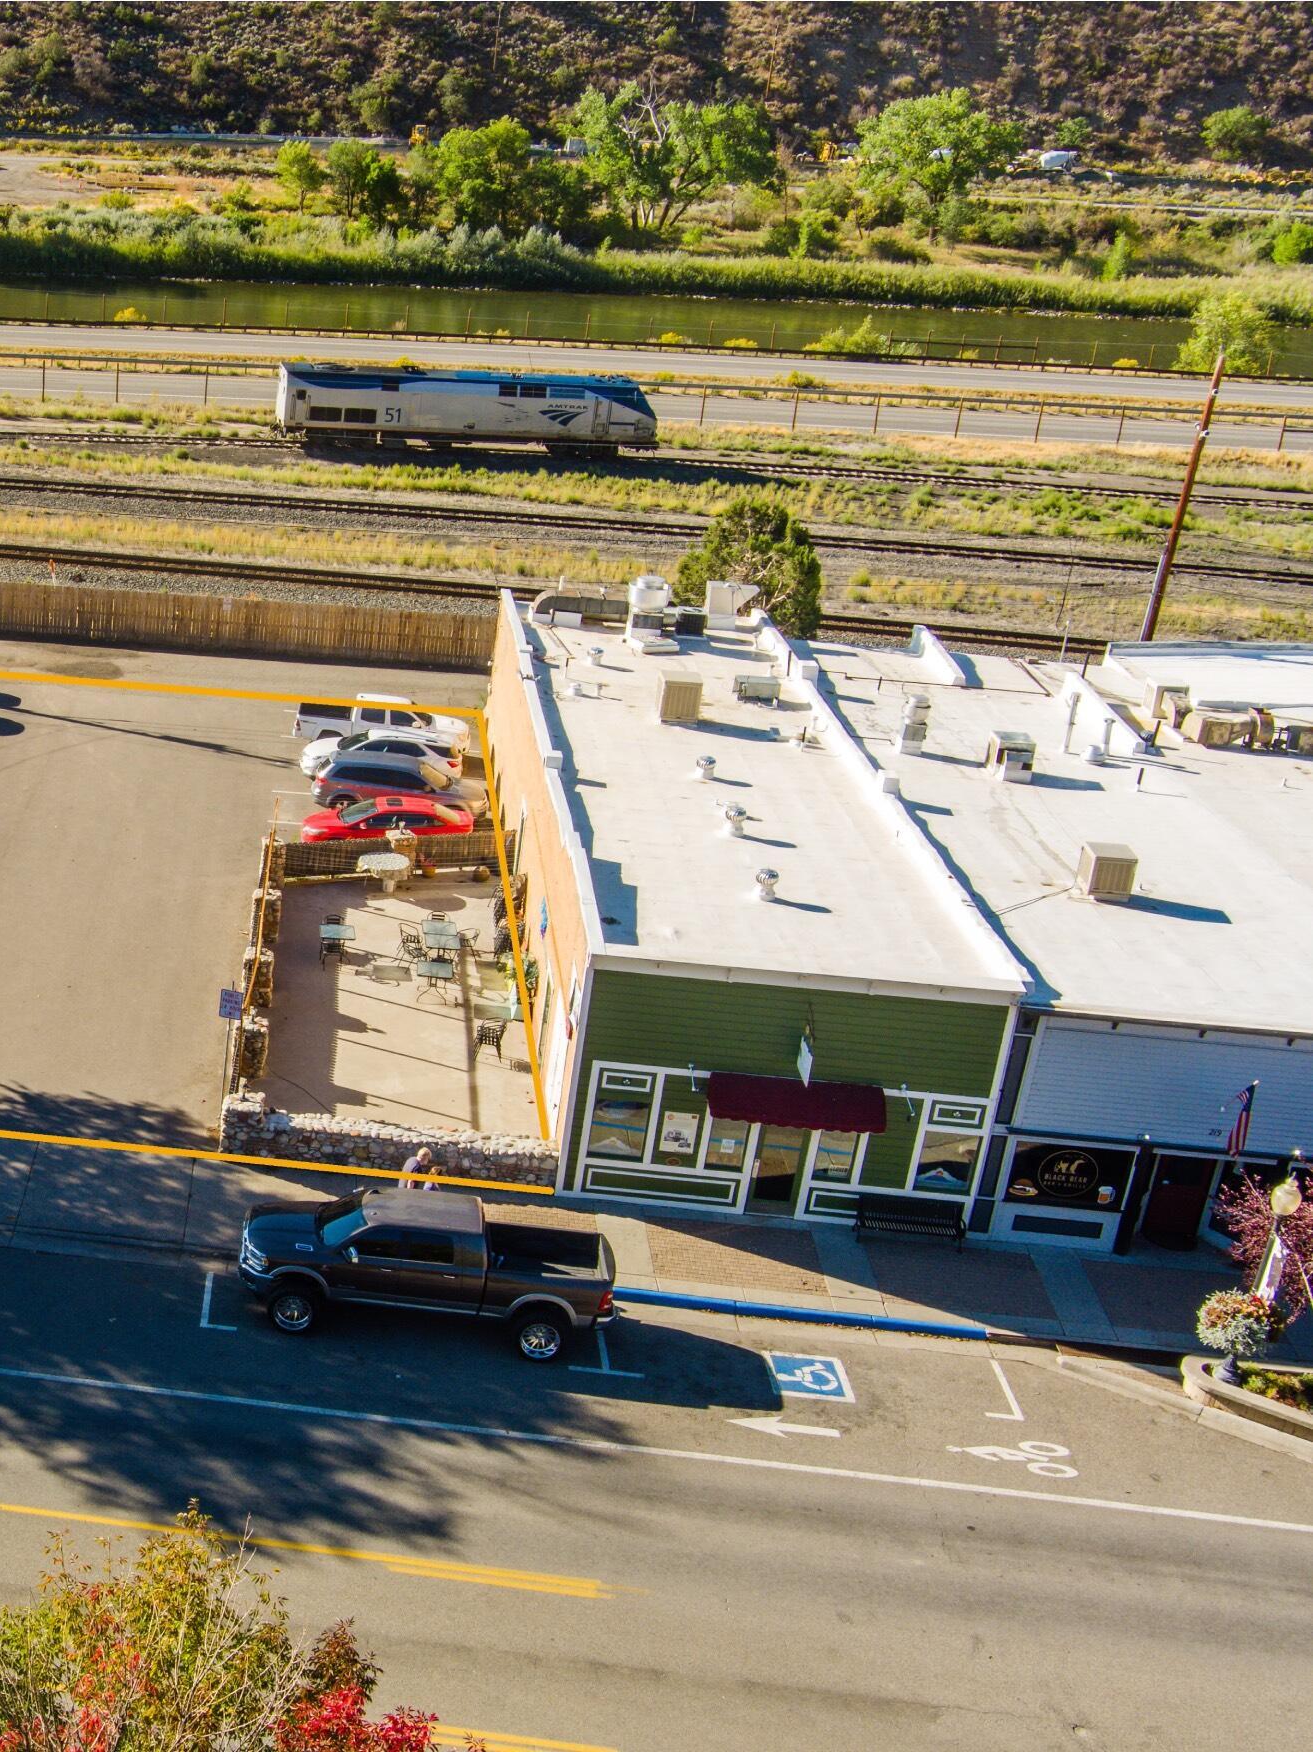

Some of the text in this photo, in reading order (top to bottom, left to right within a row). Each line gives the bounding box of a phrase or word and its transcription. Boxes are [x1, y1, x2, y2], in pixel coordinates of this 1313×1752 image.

[548, 403, 589, 411] AMTRAK
[384, 407, 402, 423] 51
[1044, 1173, 1088, 1184] BLACK BEAR
